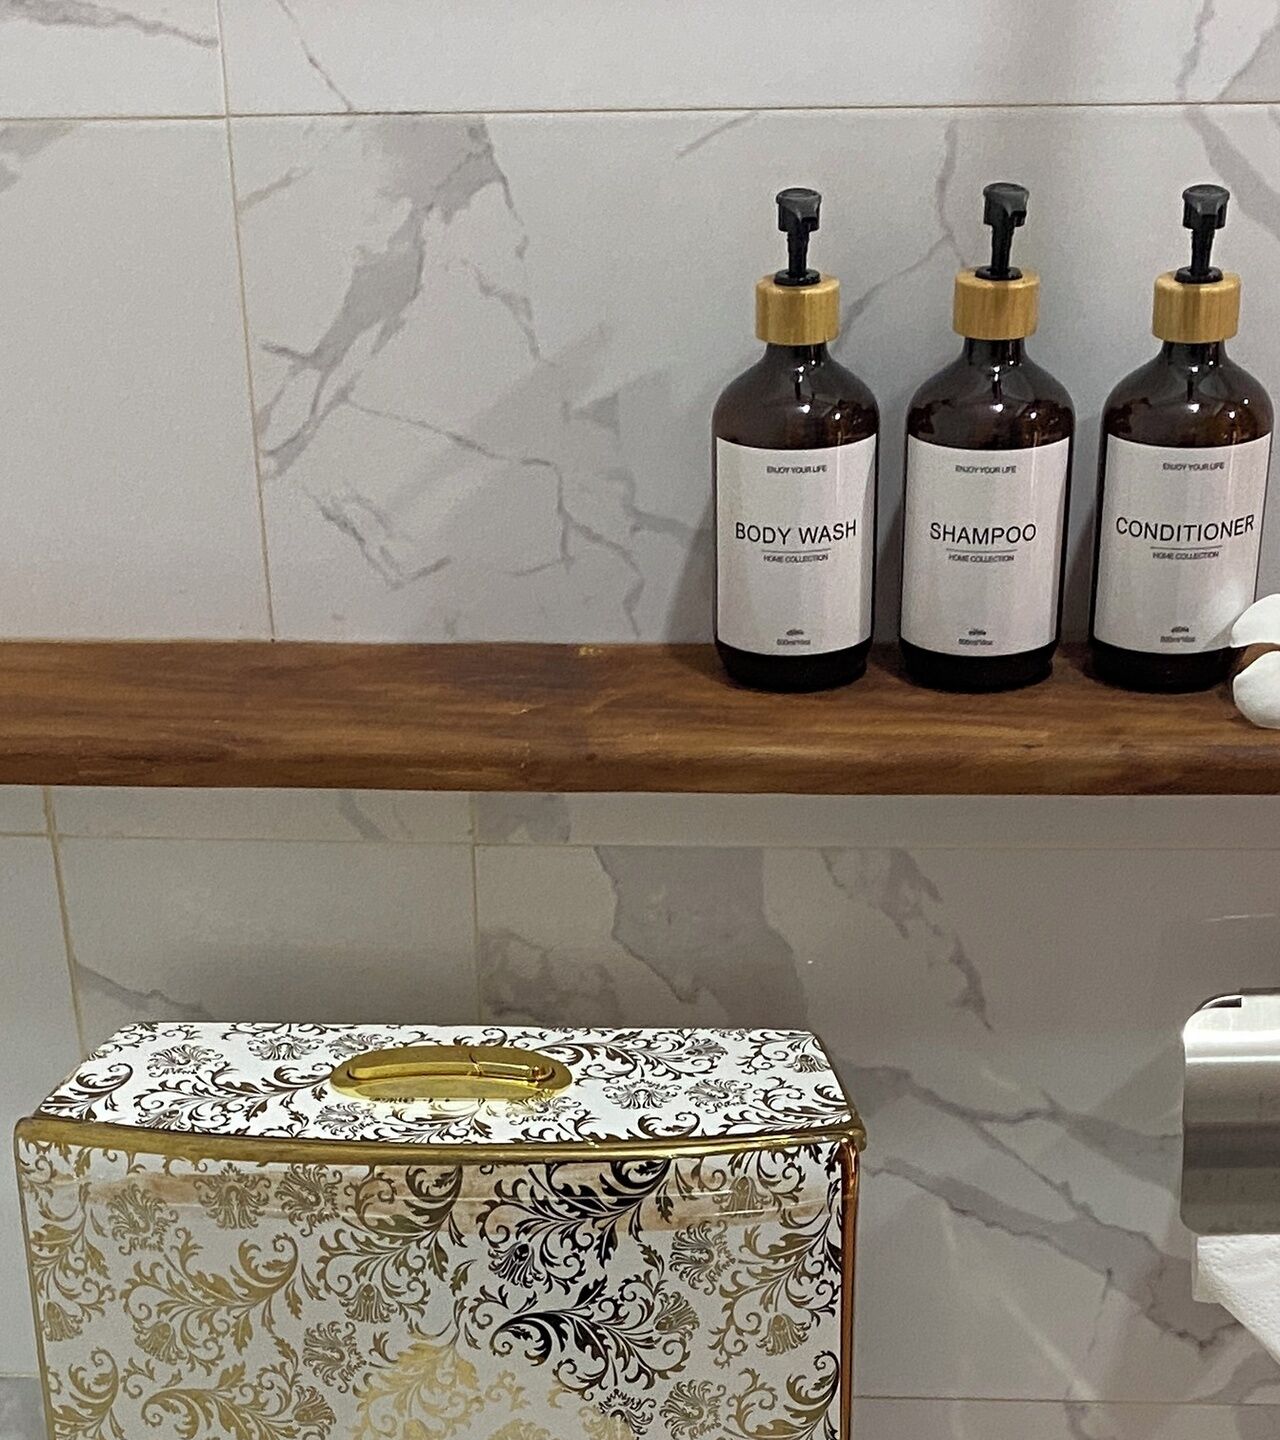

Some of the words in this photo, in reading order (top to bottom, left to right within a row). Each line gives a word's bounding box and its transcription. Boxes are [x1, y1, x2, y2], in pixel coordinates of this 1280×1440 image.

[790, 465, 812, 474] YOUR
[812, 464, 827, 473] LIFE
[979, 465, 1001, 474] YOUR
[1001, 465, 1017, 474] LIFE
[1187, 462, 1209, 471] YOUR
[1209, 461, 1225, 471] LIFE
[735, 521, 792, 545] BODY
[798, 518, 858, 545] WASH
[1115, 513, 1256, 543] CONDITIONER
[929, 521, 1038, 546] SHAMPOO
[763, 554, 784, 563] HOME
[784, 553, 829, 563] COLLECTION
[948, 553, 970, 562] HOME
[970, 554, 1015, 563] COLLECTION
[1152, 551, 1174, 560] HOME
[1175, 550, 1220, 560] COLLECTION
